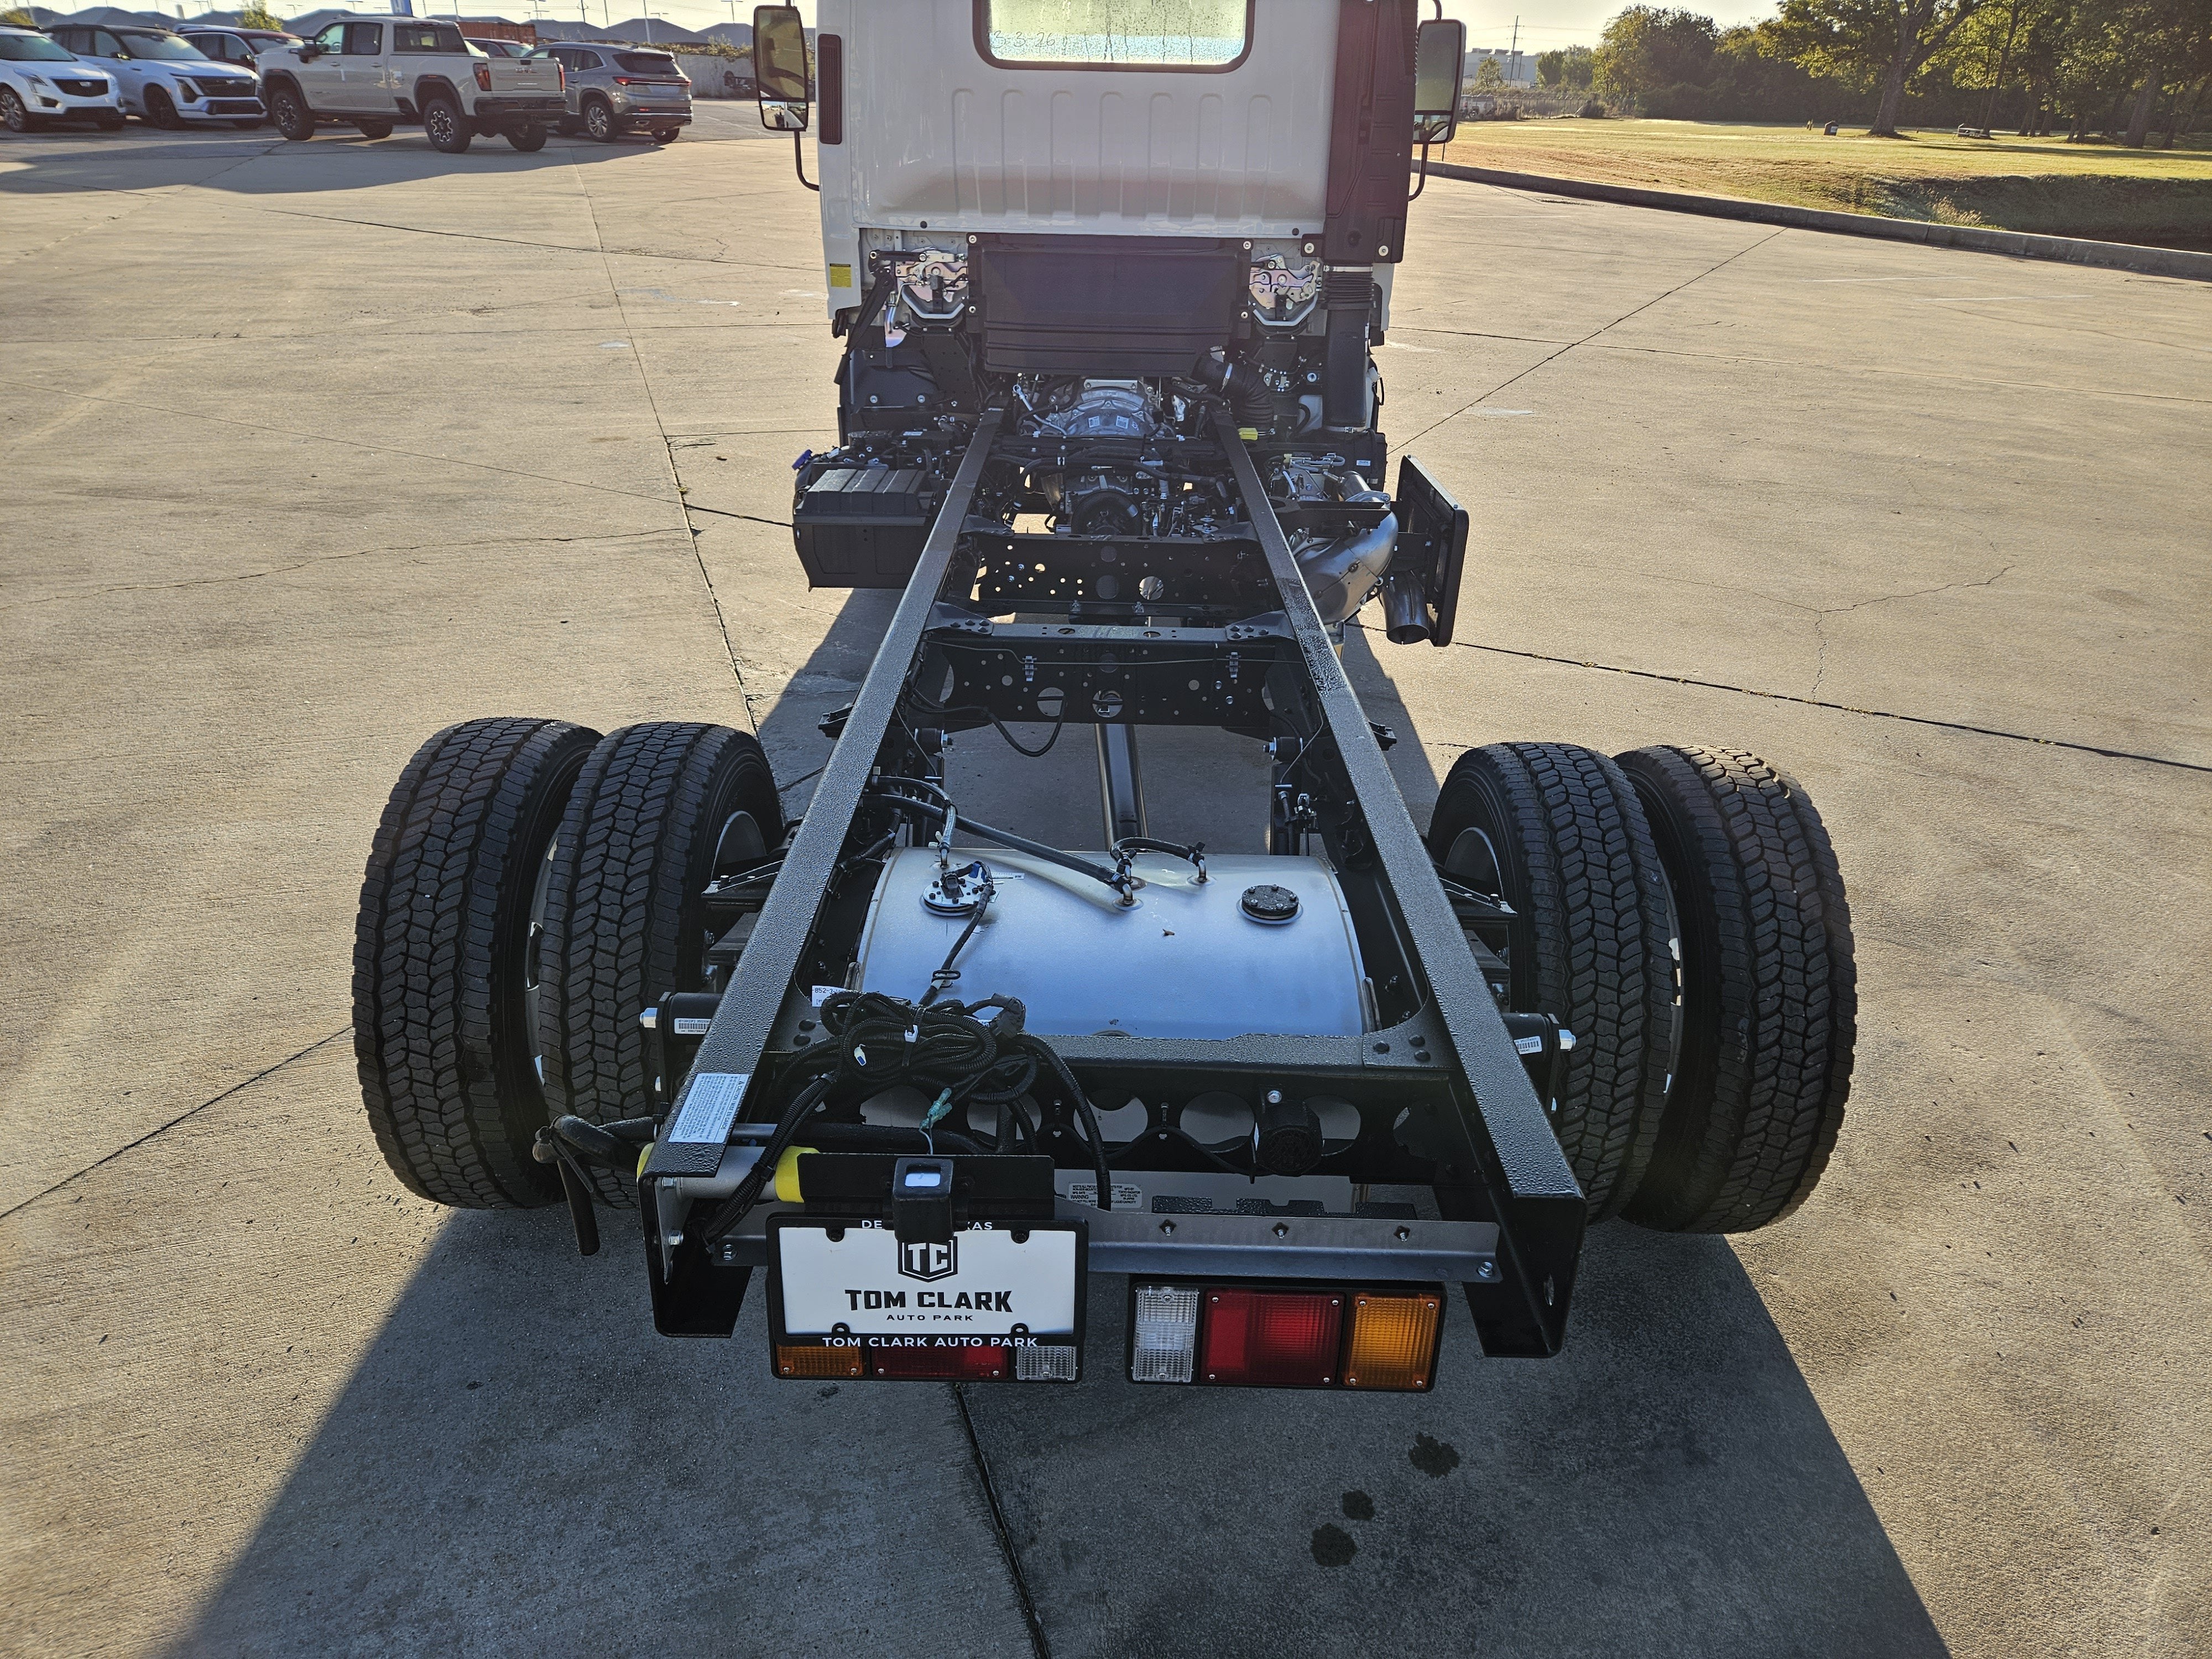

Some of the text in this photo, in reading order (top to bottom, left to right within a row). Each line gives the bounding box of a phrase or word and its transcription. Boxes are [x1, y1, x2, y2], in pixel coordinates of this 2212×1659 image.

[992, 30, 1055, 49] 3-3-26
[907, 1242, 948, 1273] TC
[844, 1290, 1013, 1313] TOM CLARK
[822, 1337, 1037, 1347] TOM CLARK AUTO PARK
